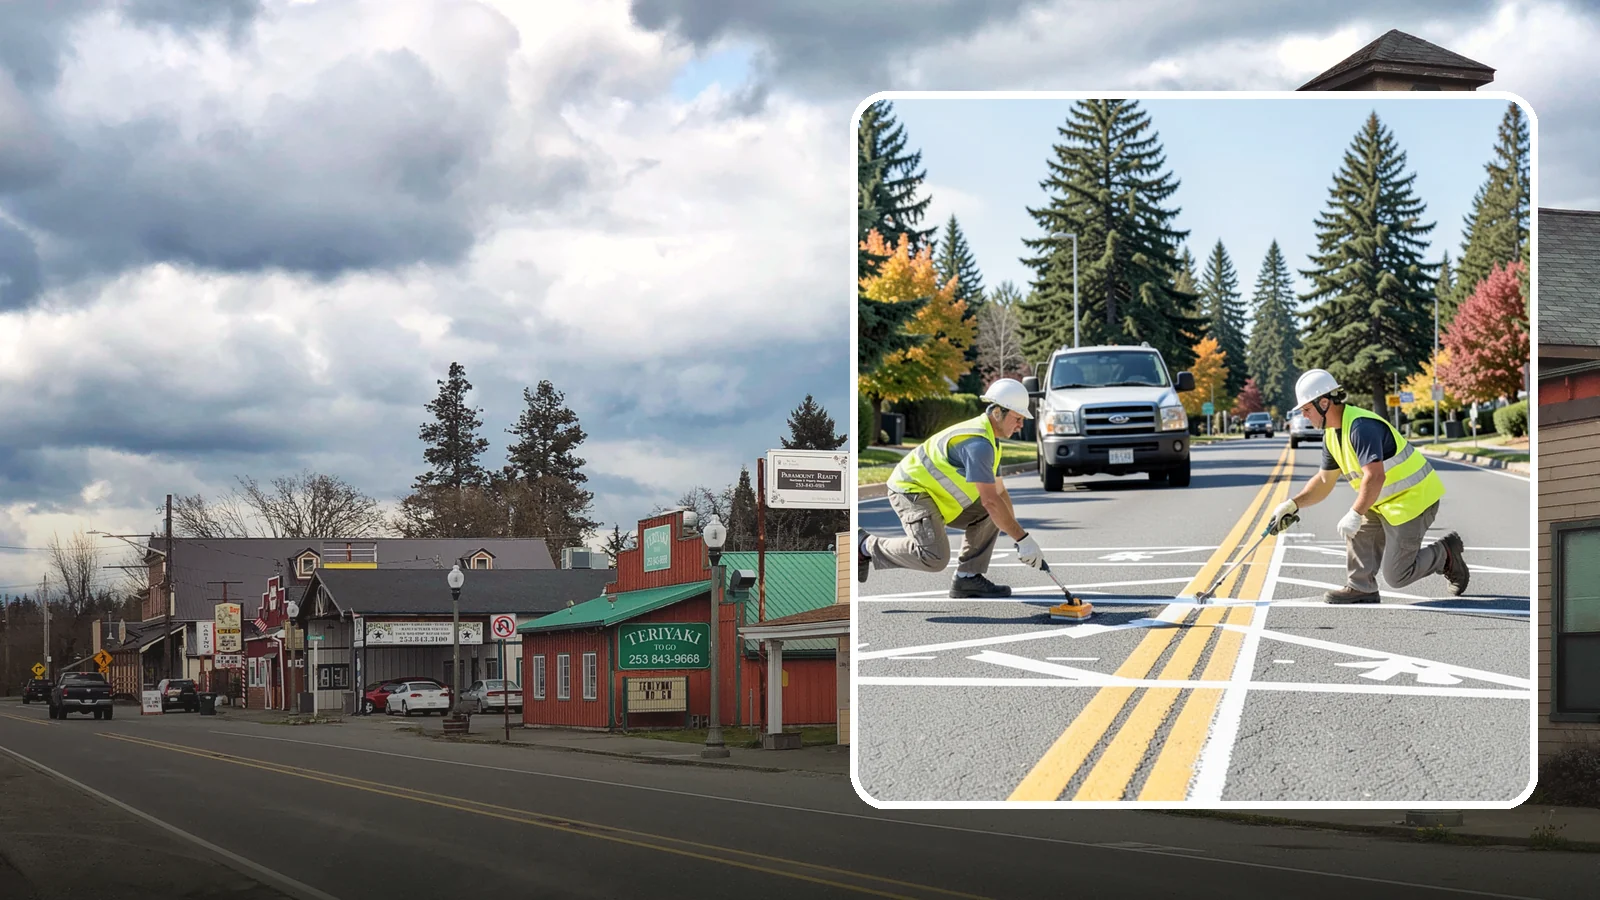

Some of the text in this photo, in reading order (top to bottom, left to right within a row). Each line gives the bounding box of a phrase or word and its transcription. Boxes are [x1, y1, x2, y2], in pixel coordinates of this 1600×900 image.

[625, 627, 702, 646] TERIYAKI
[628, 654, 700, 665] 253 843-9668
